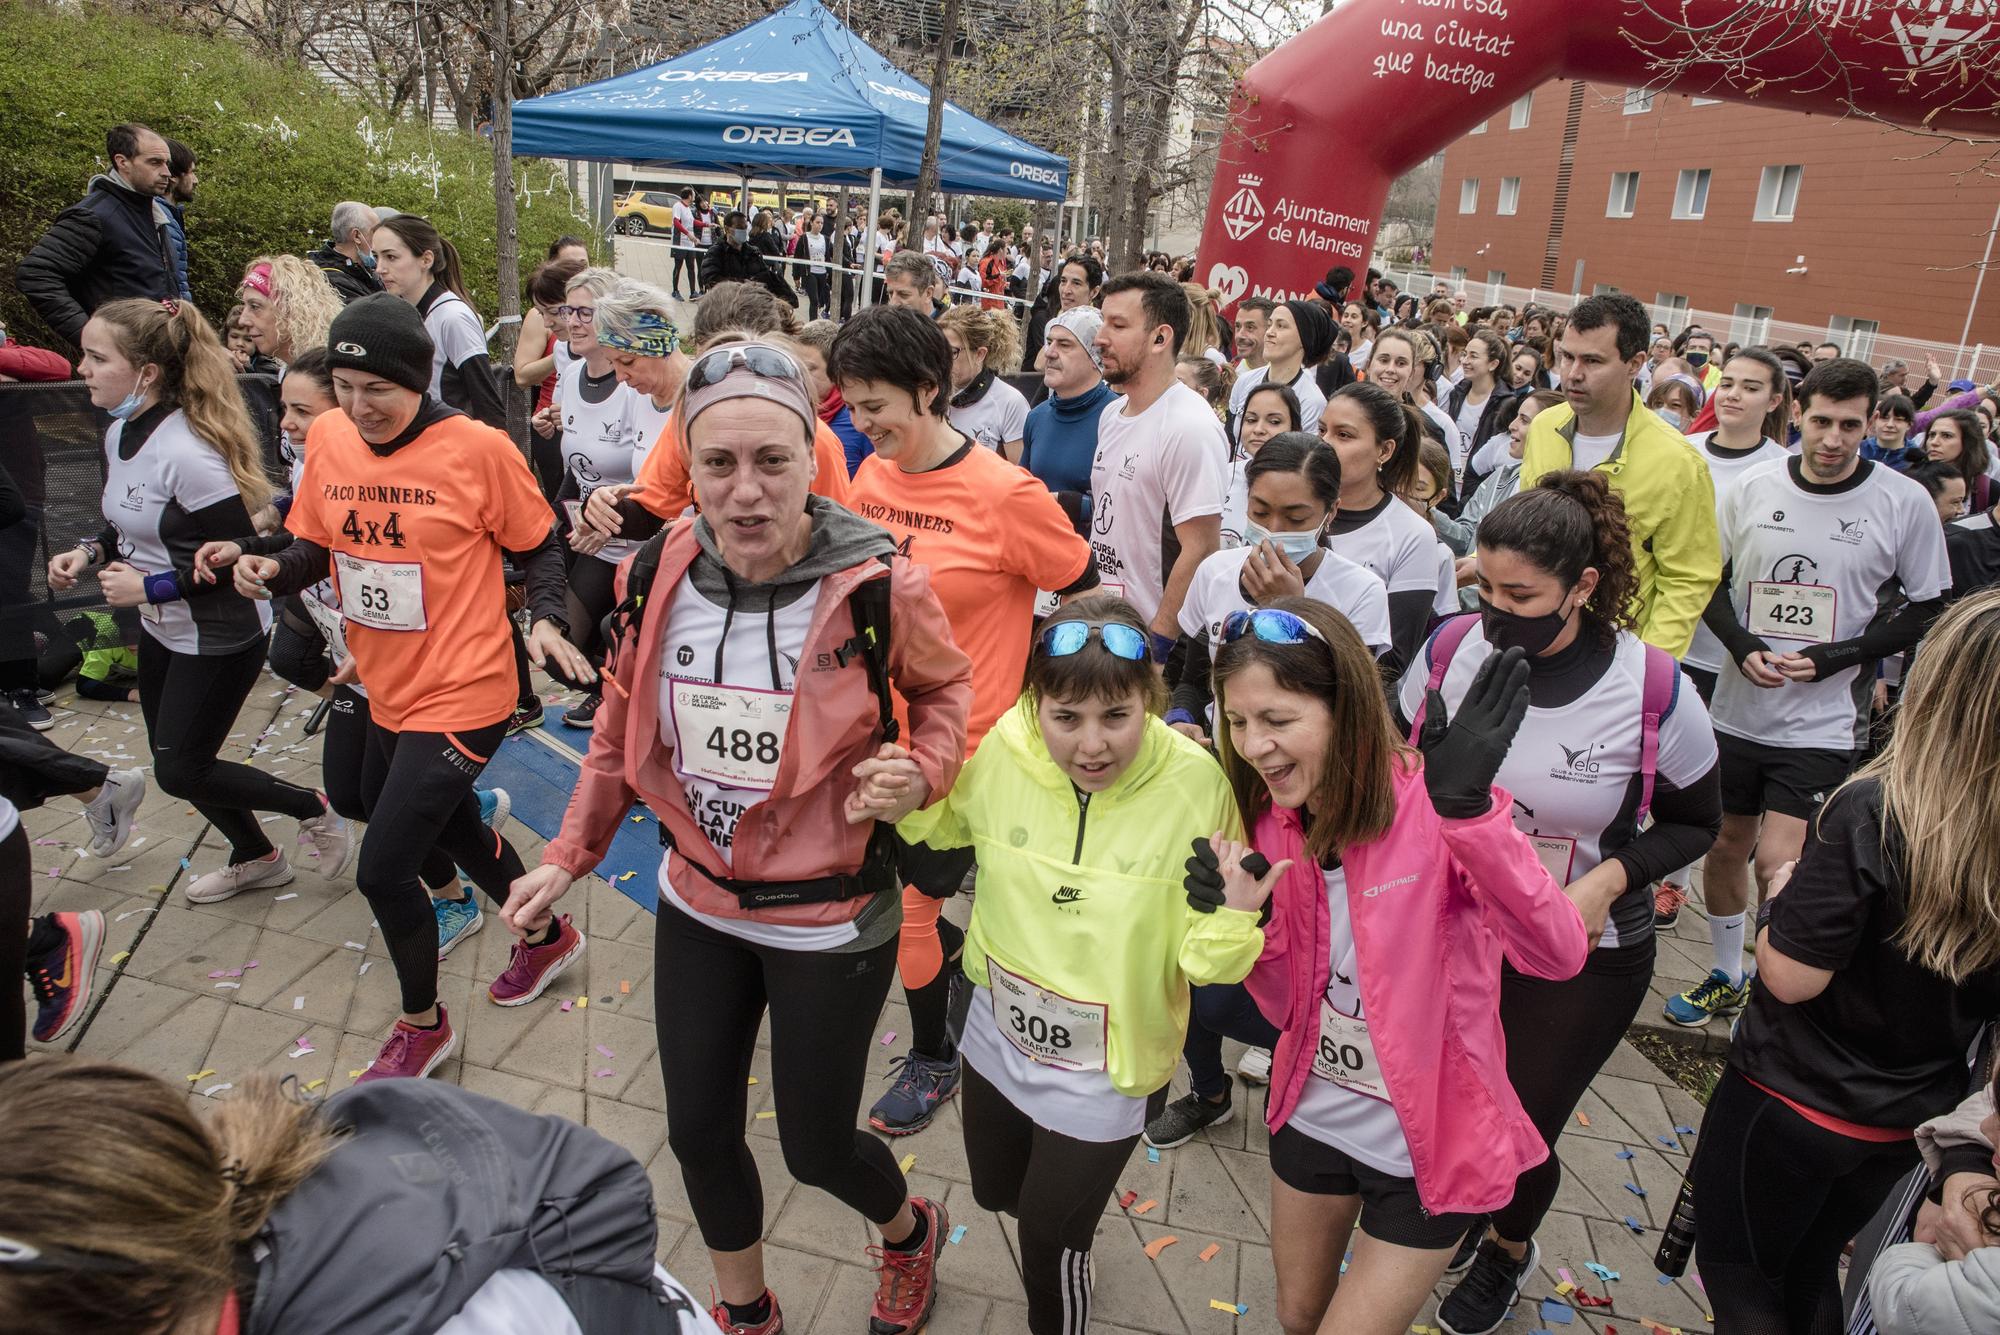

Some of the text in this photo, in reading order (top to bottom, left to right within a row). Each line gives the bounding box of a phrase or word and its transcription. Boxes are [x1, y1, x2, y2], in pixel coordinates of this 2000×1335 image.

[1381, 18, 1515, 57] una ciutat
[657, 70, 808, 83] ORBEA
[1373, 52, 1495, 95] que batega
[723, 126, 856, 148] ORBEA
[1010, 161, 1060, 187] ORBEA
[1273, 197, 1370, 235] Ajuntament
[1268, 222, 1363, 259] de Manresa
[324, 484, 436, 506] PACO RUNNERS
[861, 502, 954, 534] PACO RUNNERS
[1091, 541, 1116, 558] CURSA
[1097, 562, 1118, 577] RESA
[1100, 553, 1124, 569] DONA
[361, 584, 389, 611] 53
[362, 609, 390, 620] GEMMA
[1769, 604, 1813, 626] 423
[706, 726, 779, 765] 488
[1551, 767, 1567, 775] CLUB
[755, 893, 799, 901] Quechua
[1057, 885, 1082, 899] NIKE
[1009, 1005, 1072, 1049] 308
[1020, 1035, 1058, 1056] MARTA
[1318, 1059, 1348, 1078] ROSA
